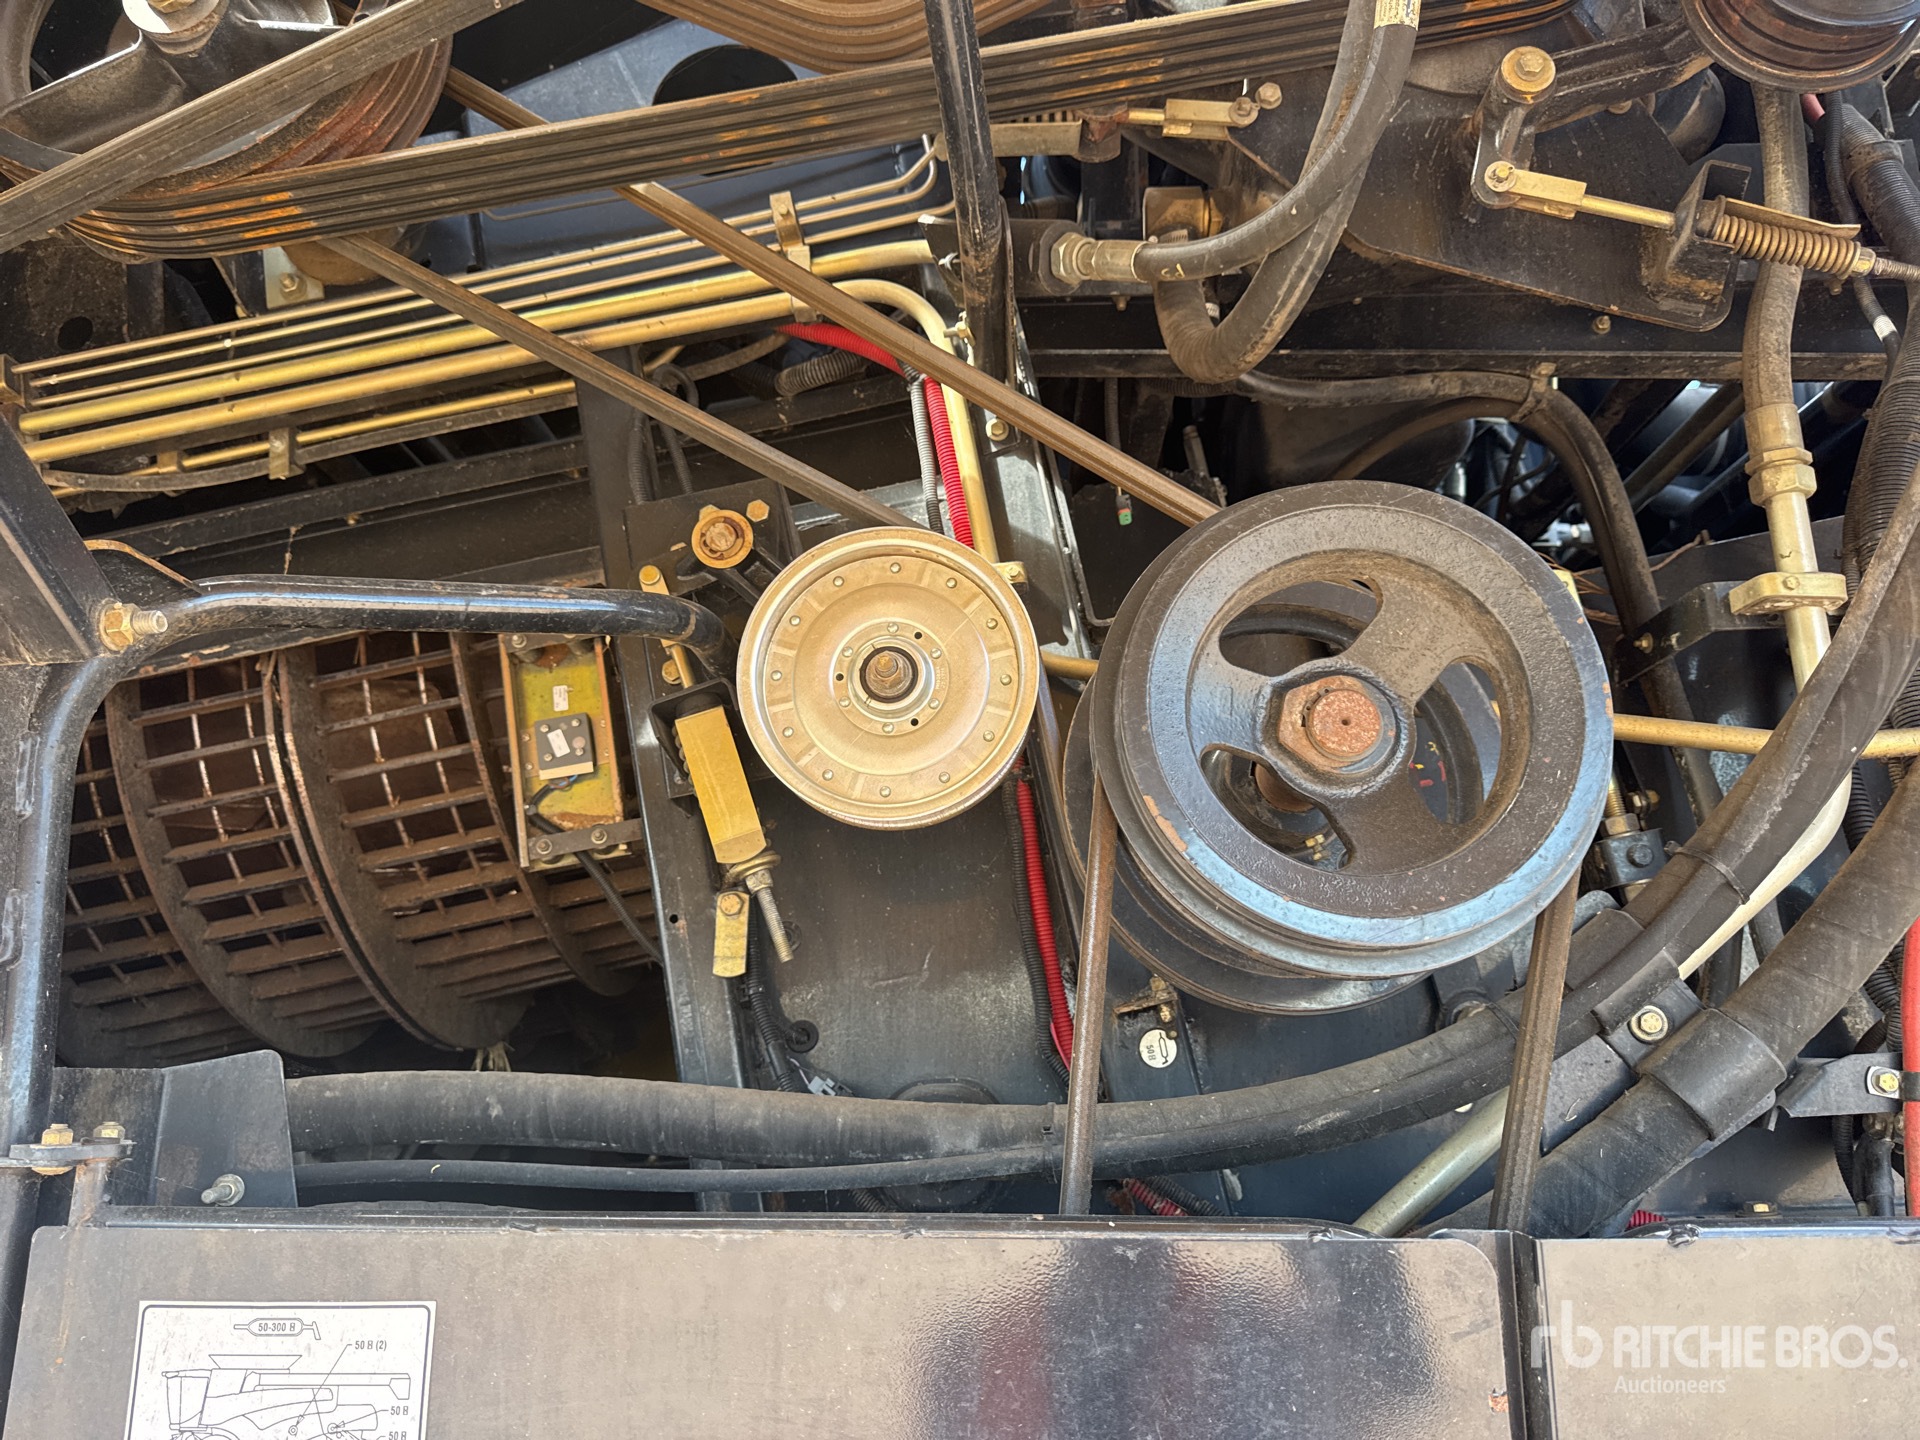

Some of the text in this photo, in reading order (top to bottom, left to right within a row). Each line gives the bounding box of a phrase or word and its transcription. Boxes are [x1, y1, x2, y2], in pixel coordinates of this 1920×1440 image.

[258, 1322, 287, 1332] 50-300
[355, 1340, 365, 1350] 50
[375, 1340, 387, 1351] (2)
[390, 1405, 401, 1415] 50
